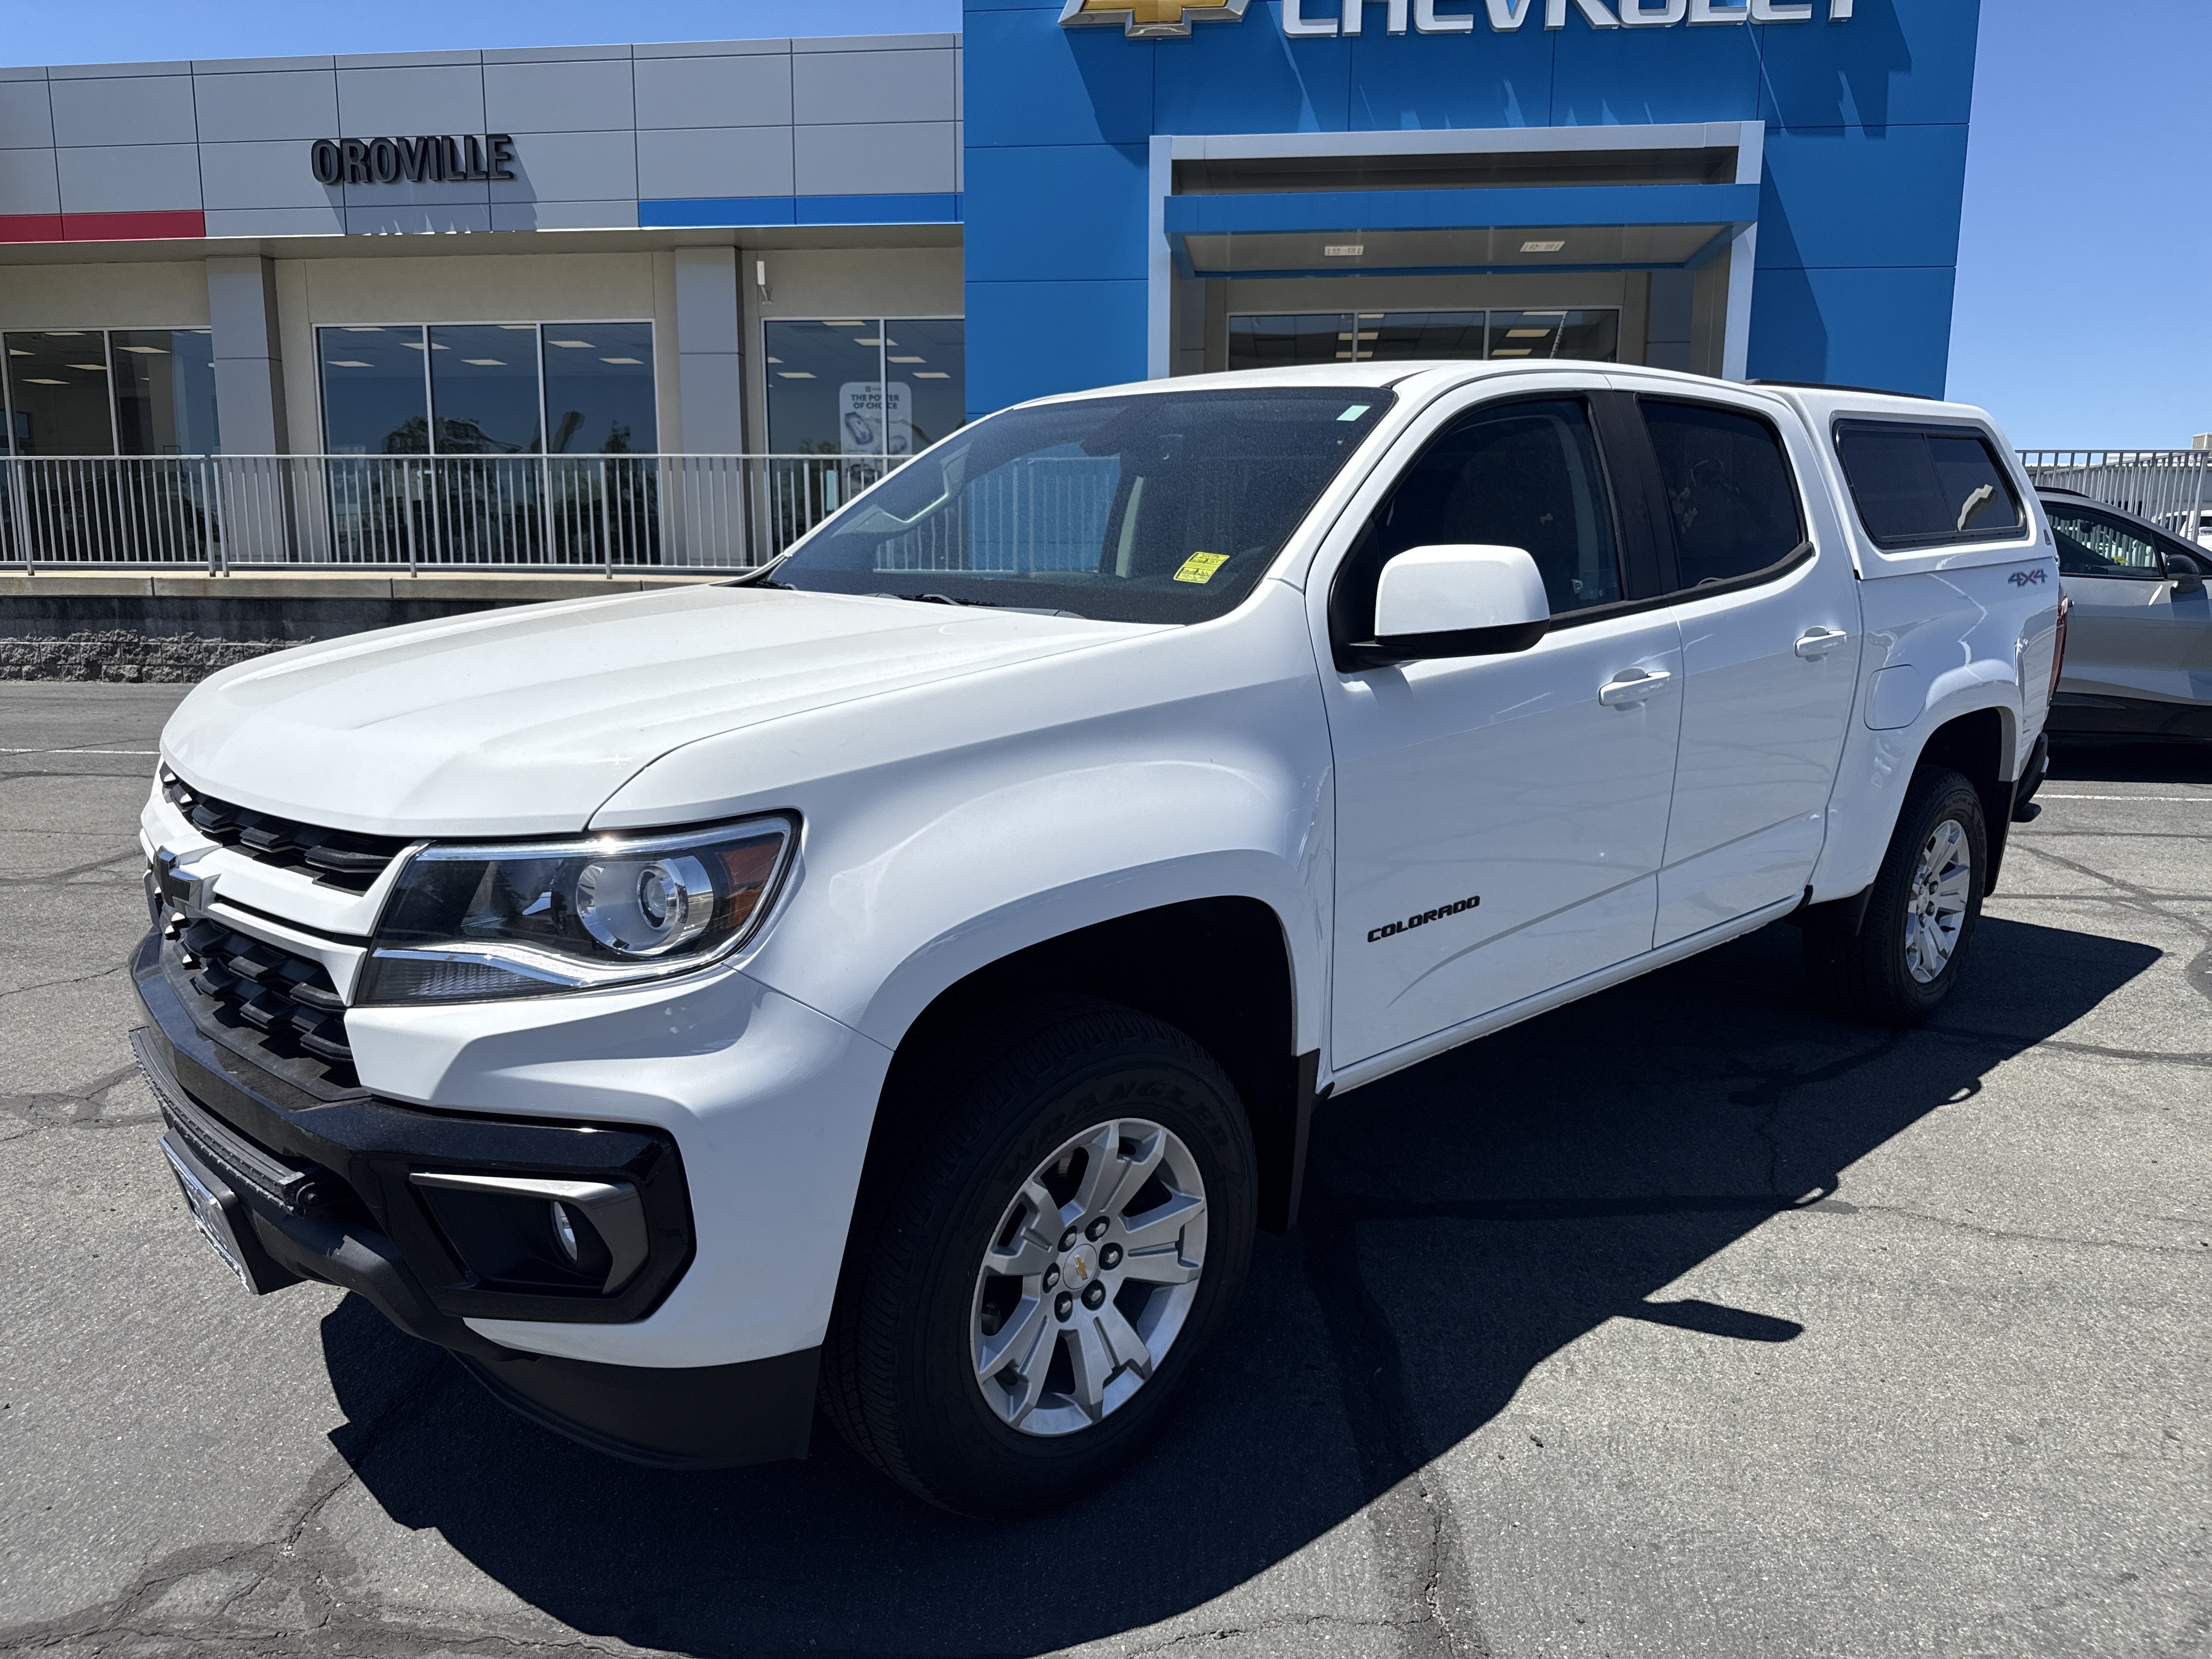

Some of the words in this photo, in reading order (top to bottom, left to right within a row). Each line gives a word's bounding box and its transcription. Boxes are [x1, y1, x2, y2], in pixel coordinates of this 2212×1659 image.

[312, 134, 514, 184] OROVILLE
[1368, 895, 1480, 943] COLORADO
[997, 1080, 1229, 1183] WRANGLER
